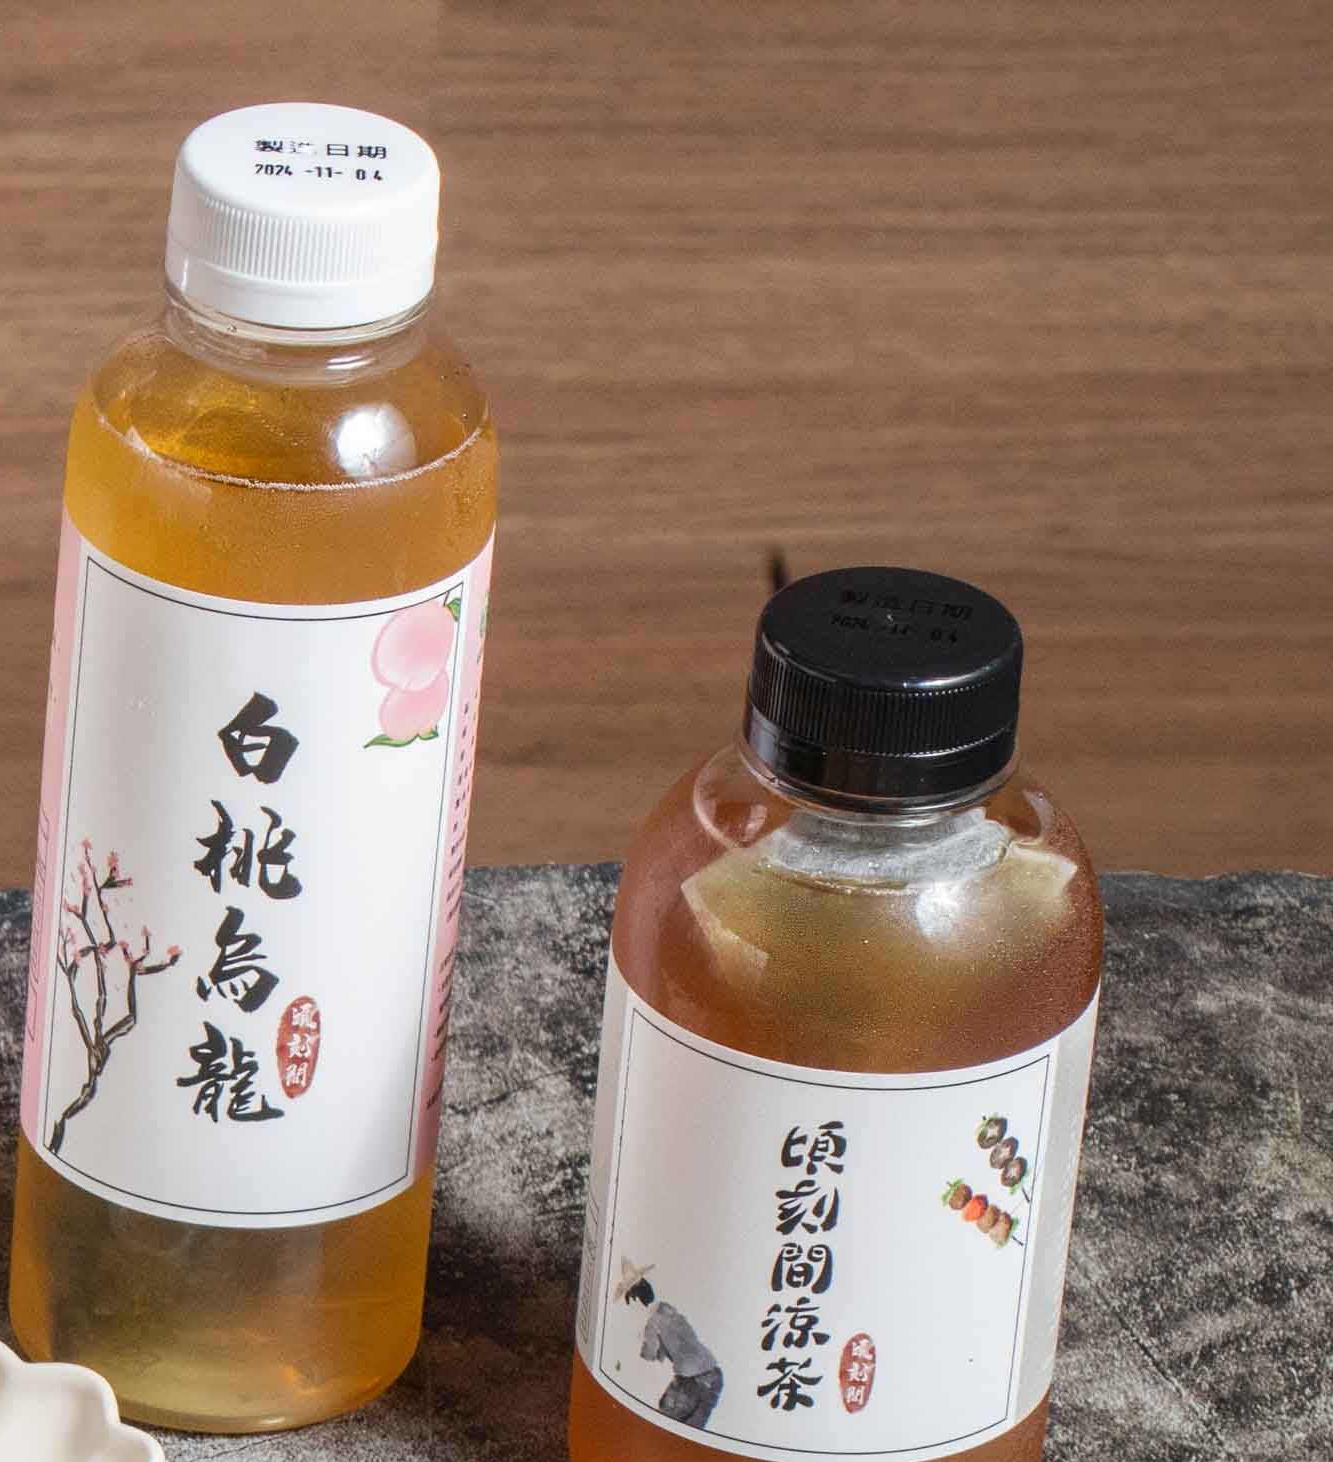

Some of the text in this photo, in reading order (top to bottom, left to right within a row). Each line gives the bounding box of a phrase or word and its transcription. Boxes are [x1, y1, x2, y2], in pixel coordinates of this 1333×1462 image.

[254, 163, 293, 178] 2024
[175, 691, 303, 1124] 白桃烏龍
[756, 1119, 848, 1413] 頃刻間涼茶
